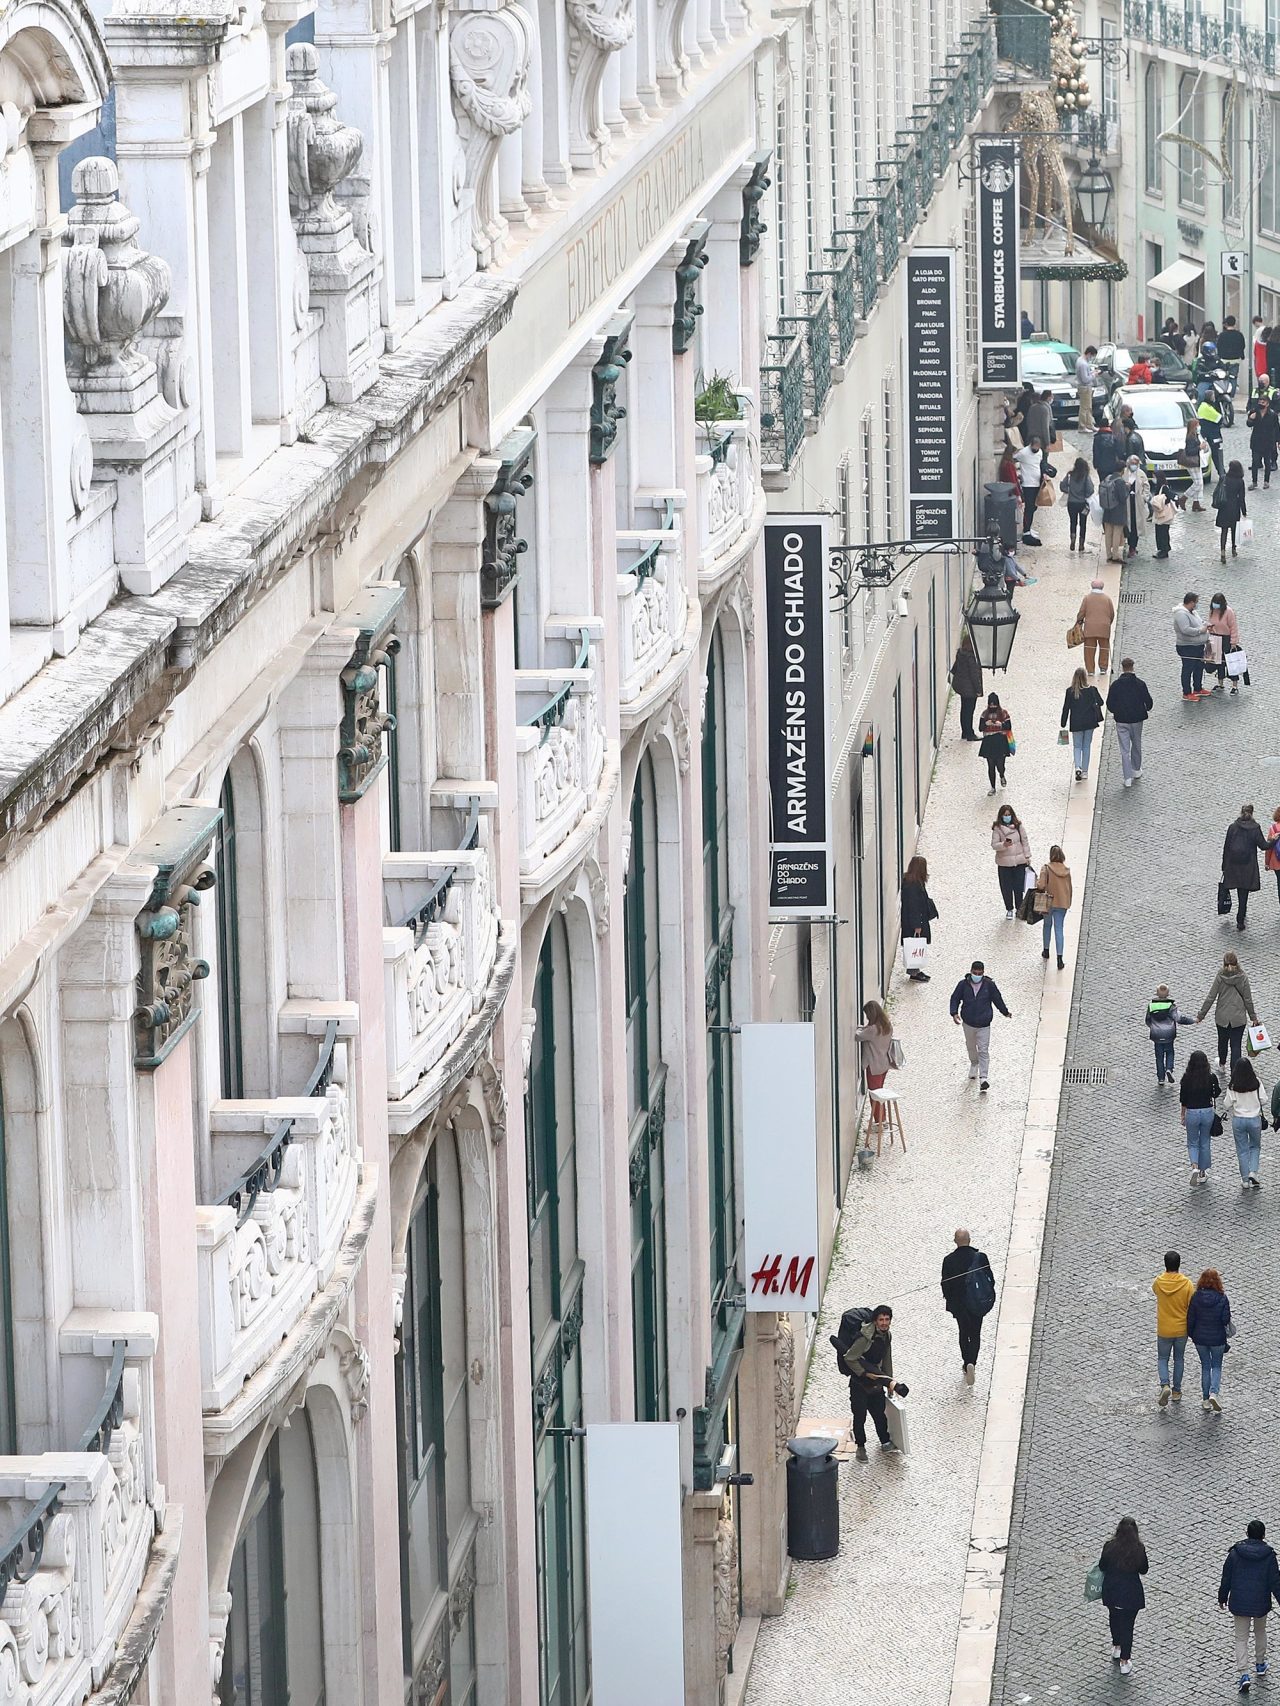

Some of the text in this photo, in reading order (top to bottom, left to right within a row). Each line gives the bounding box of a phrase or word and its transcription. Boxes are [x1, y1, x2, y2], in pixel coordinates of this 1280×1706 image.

[566, 118, 705, 330] EDIFICIO GRANDELLA
[992, 198, 1004, 329] STARBUCKS COFFEE
[782, 533, 807, 835] ARMAZÉNS DO CHIADO
[751, 1254, 815, 1298] H&M
